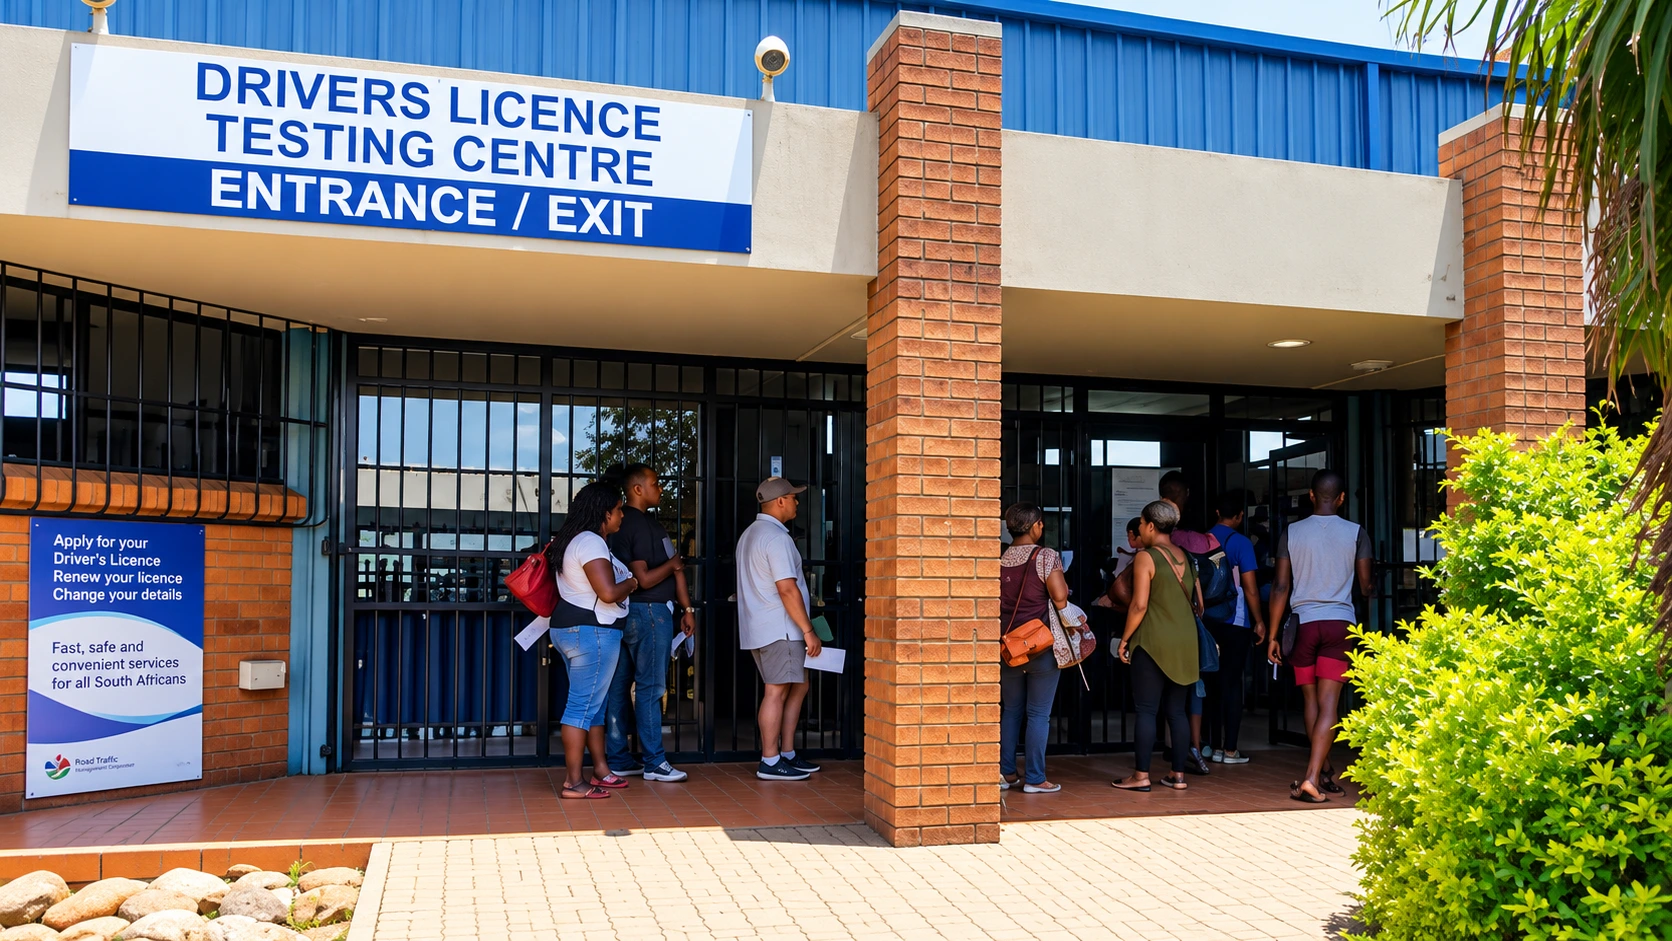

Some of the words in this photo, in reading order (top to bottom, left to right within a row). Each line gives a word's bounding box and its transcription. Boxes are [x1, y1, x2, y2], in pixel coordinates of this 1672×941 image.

[197, 62, 431, 120] DRIVERS
[450, 86, 661, 142] LICENCE
[206, 114, 434, 169] TESTING
[453, 135, 653, 187] CENTRE
[211, 168, 496, 227] ENTRANCE
[511, 192, 531, 231] /
[548, 194, 653, 238] EXIT
[53, 534, 94, 551] Apply
[96, 535, 116, 548] for
[118, 539, 149, 552] your
[53, 552, 107, 566] Driver's
[110, 554, 161, 567] Licence
[53, 570, 101, 583] Renew
[104, 574, 135, 586] your
[137, 571, 183, 584] licence
[53, 588, 105, 603] Change
[108, 591, 139, 603] your
[141, 588, 183, 601] details
[52, 641, 85, 655] Fast,
[88, 641, 117, 653] safe
[120, 640, 144, 653] and
[51, 659, 126, 672] convenient
[128, 659, 179, 669] services
[51, 677, 72, 689] for
[75, 676, 91, 689] all
[94, 675, 133, 688] South
[136, 674, 187, 686] Africans
[75, 757, 95, 766] Road
